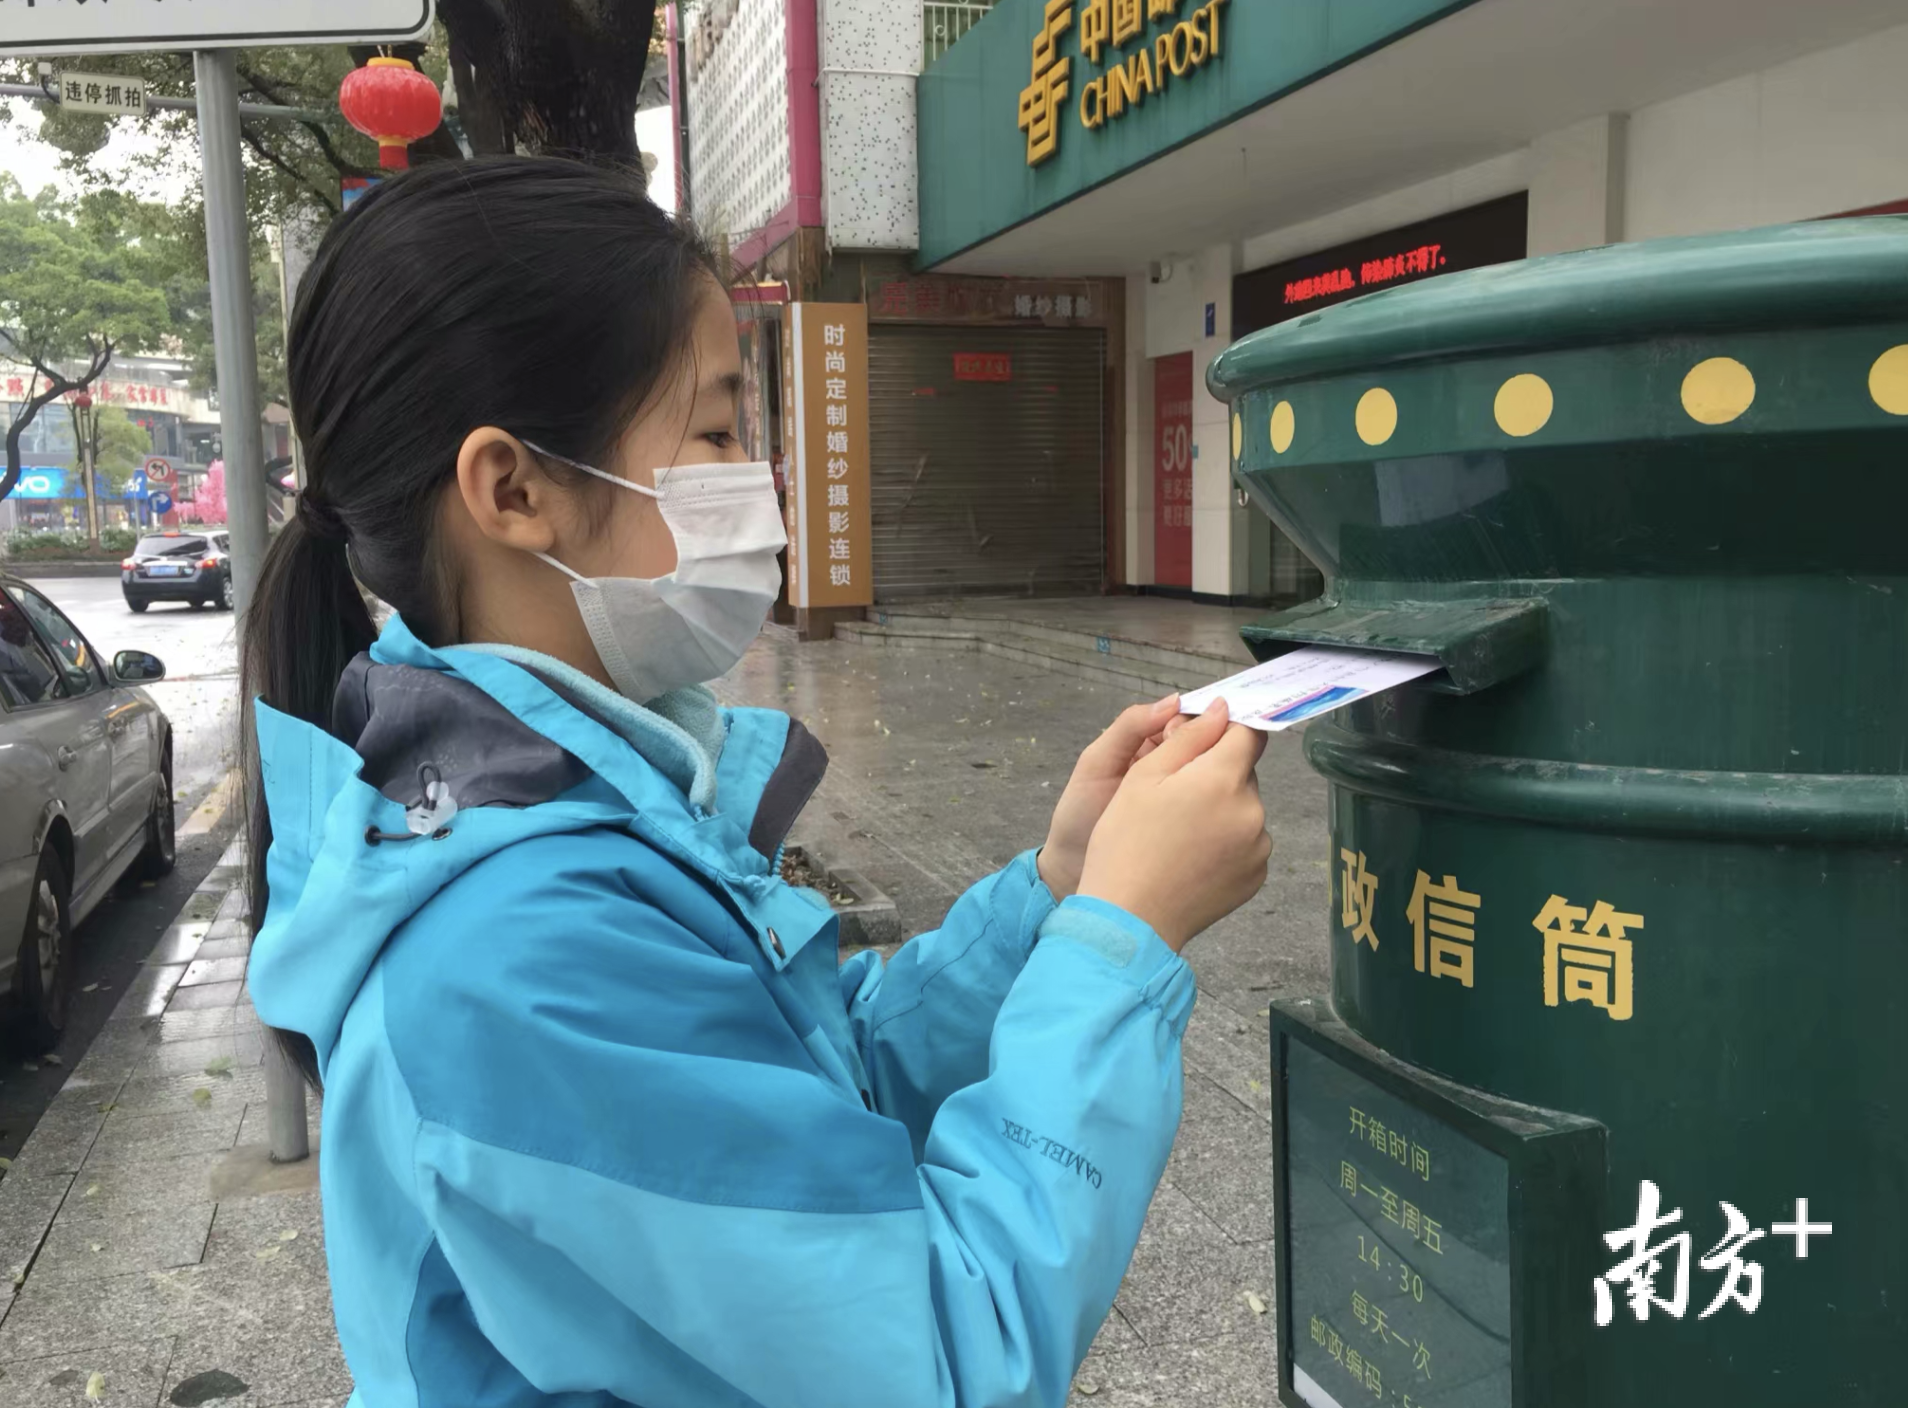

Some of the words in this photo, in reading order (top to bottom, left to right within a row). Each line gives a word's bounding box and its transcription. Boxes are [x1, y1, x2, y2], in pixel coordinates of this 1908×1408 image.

[1080, 49, 1154, 129] CHINA
[1156, 0, 1227, 91] POST
[1081, 0, 1175, 63] 中国
[65, 80, 141, 108] 违停抓拍
[823, 323, 851, 587] 时尚定制婚纱摄影连锁
[1001, 1117, 1103, 1190] CAMEL-TEX
[1348, 1105, 1430, 1182] 开箱时间
[1340, 1160, 1444, 1255] 周一至周五
[1357, 1235, 1424, 1303] 14:30
[1351, 1289, 1432, 1379] 每天一次
